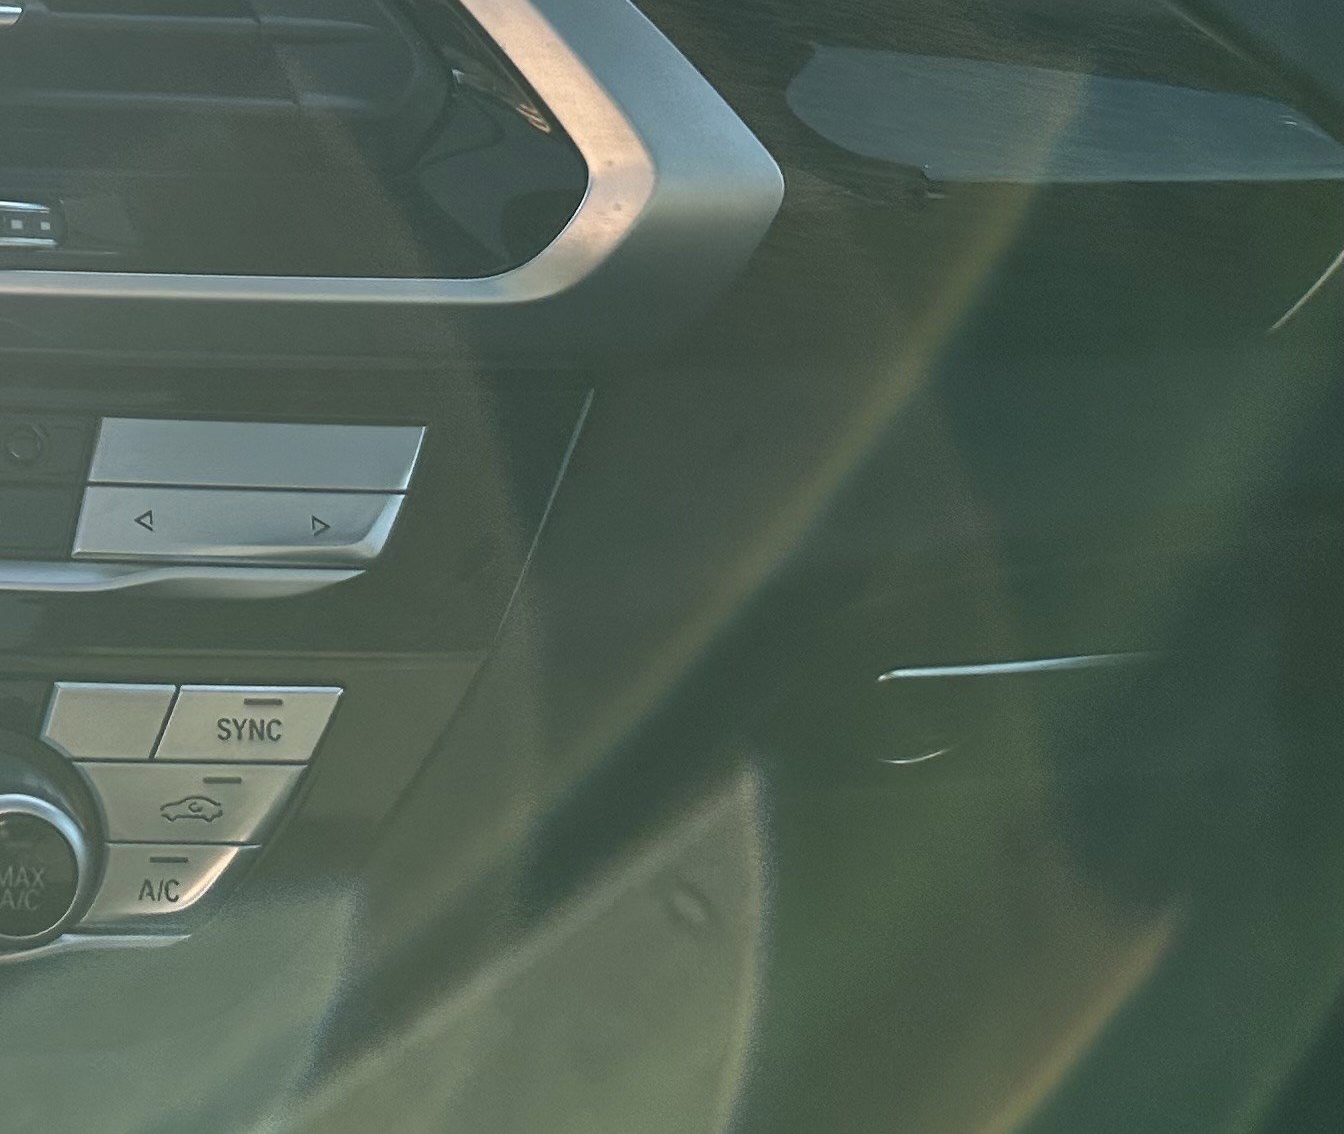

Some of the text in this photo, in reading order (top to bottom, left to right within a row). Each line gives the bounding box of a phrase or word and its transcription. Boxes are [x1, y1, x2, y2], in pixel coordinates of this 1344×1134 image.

[216, 718, 283, 744] SYNC
[0, 889, 40, 913] A/C
[137, 878, 181, 903] A/C
